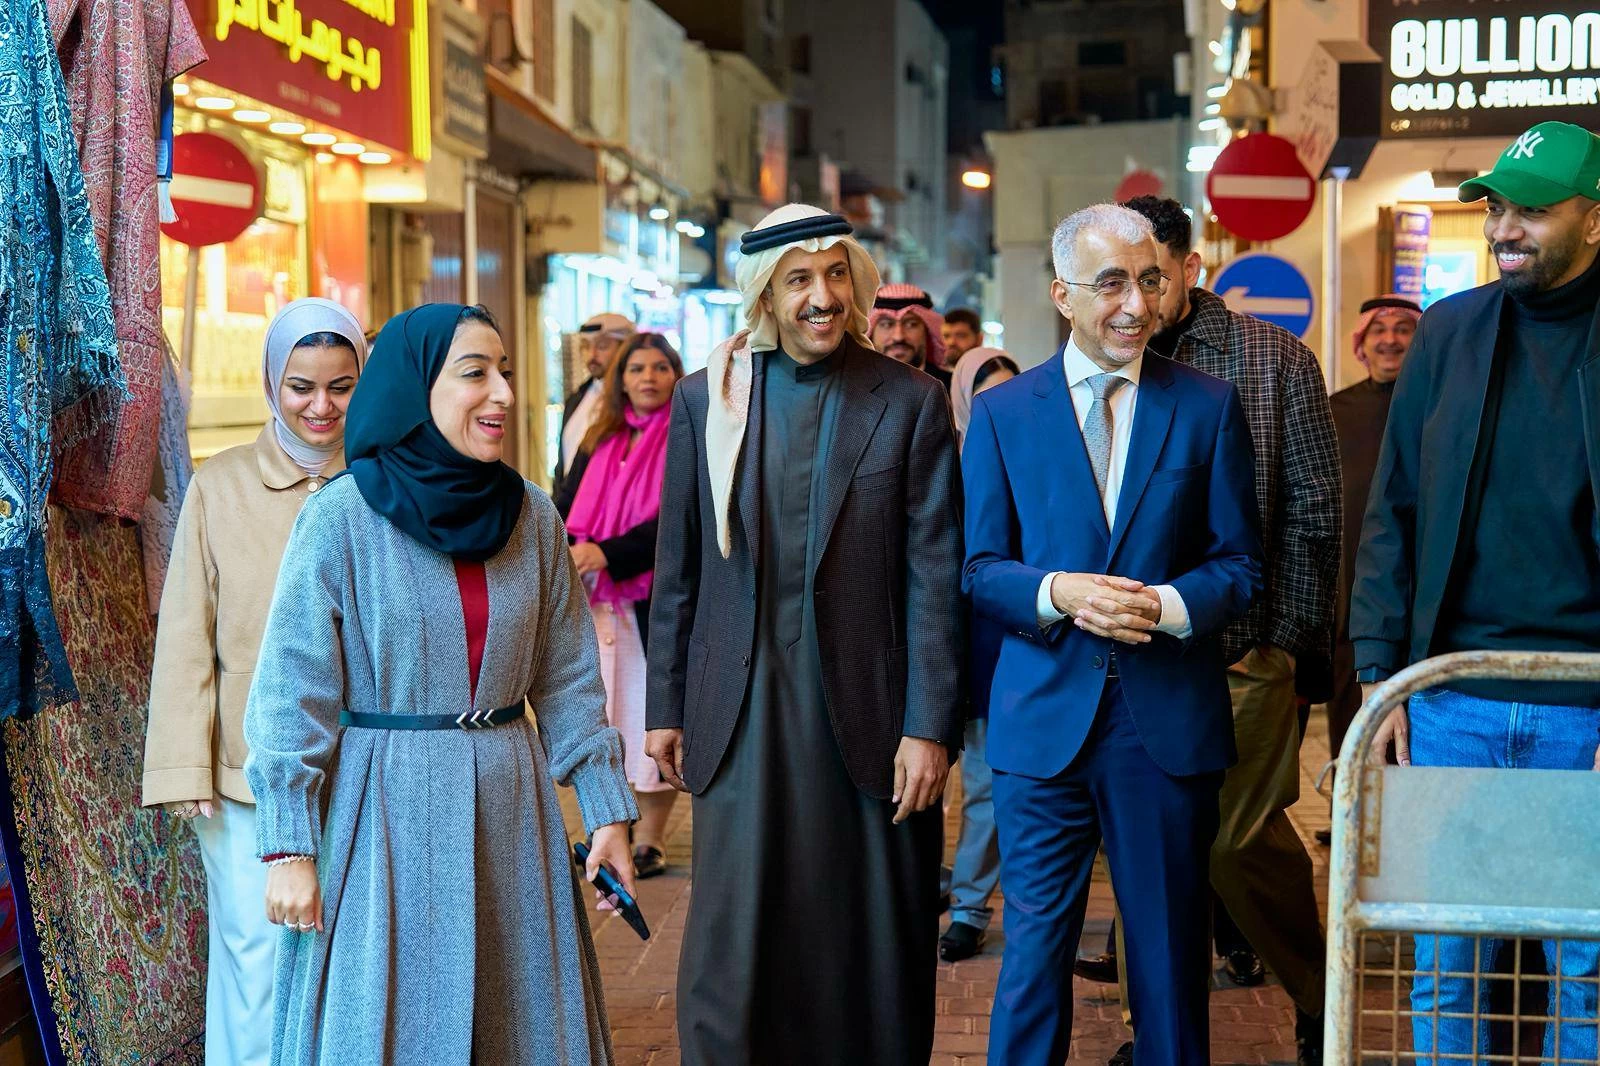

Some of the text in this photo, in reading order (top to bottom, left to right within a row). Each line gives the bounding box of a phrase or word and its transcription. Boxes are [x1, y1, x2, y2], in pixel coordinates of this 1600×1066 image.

[1390, 83, 1455, 111] GOLD
[1457, 81, 1477, 109] &
[1506, 130, 1544, 159] NY
